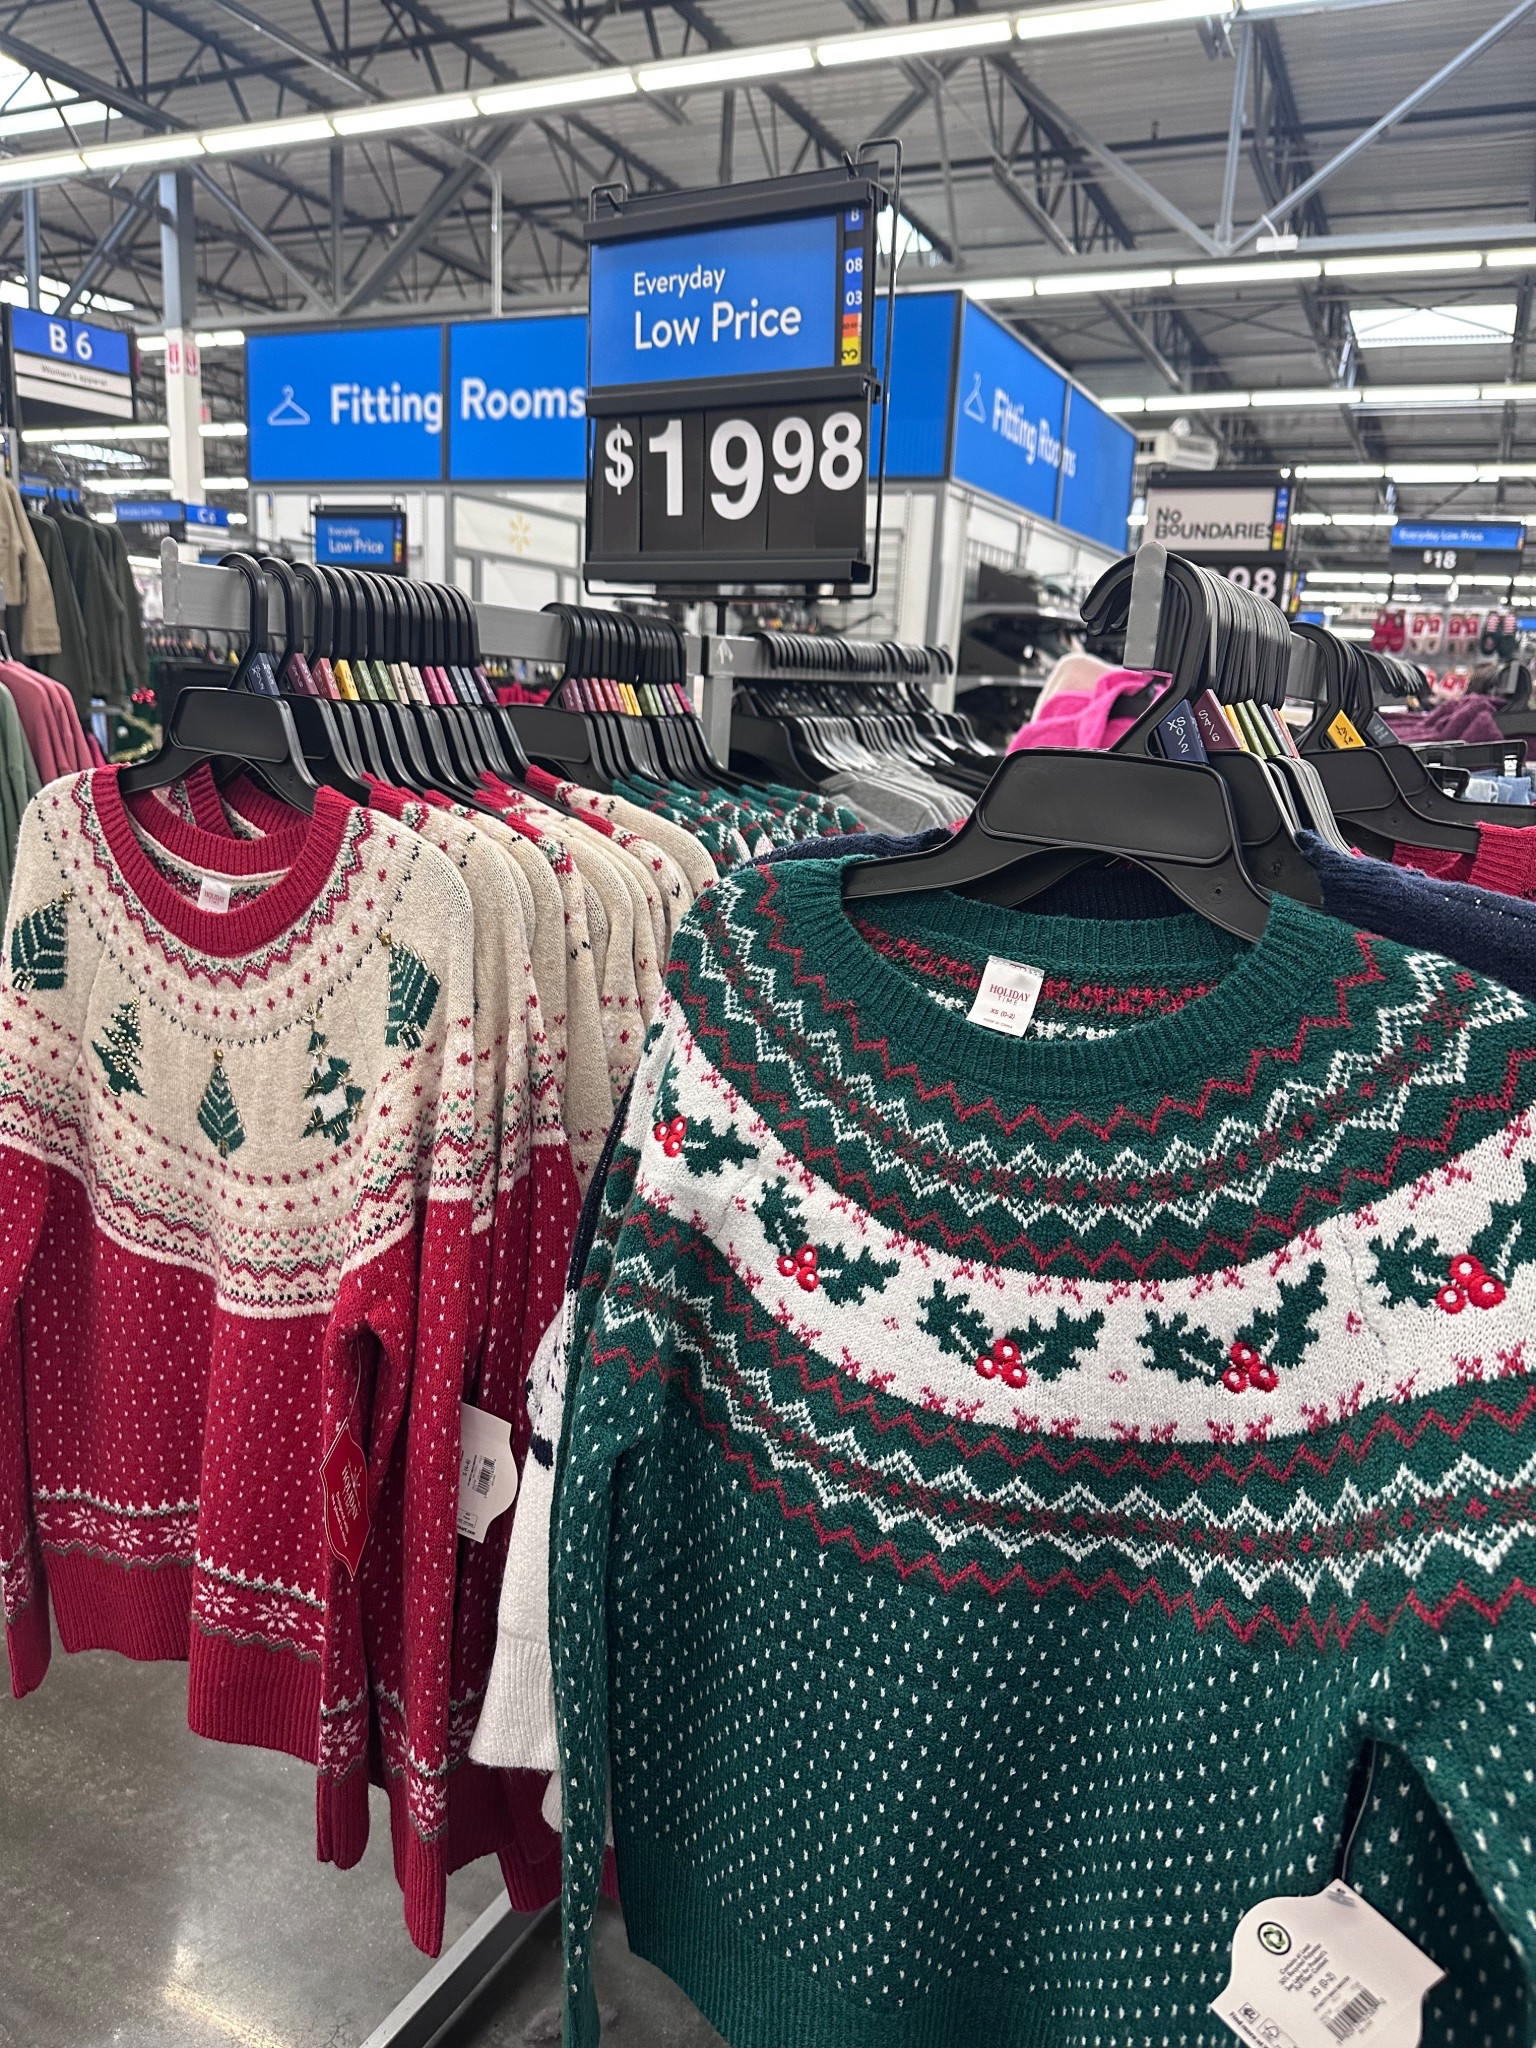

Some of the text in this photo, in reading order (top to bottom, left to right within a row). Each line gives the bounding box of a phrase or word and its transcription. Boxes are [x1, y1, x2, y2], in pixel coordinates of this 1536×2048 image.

[845, 257, 863, 274] 08
[633, 264, 726, 298] Everyday
[845, 290, 863, 307] 03
[634, 297, 802, 350] Low Price
[49, 322, 93, 361] B 6
[330, 377, 585, 433] Fitting Rooms
[992, 387, 1038, 466] Fitting
[328, 537, 385, 555] Low Price
[1167, 716, 1187, 731] XS
[989, 984, 1030, 1002] HOLIDAY
[998, 995, 1017, 1006] TIME
[990, 1007, 1016, 1020] XS (0-2)
[341, 1465, 359, 1520] HOLIDAY
[1310, 1985, 1321, 1997] XS
[1228, 2010, 1244, 2026] Find
